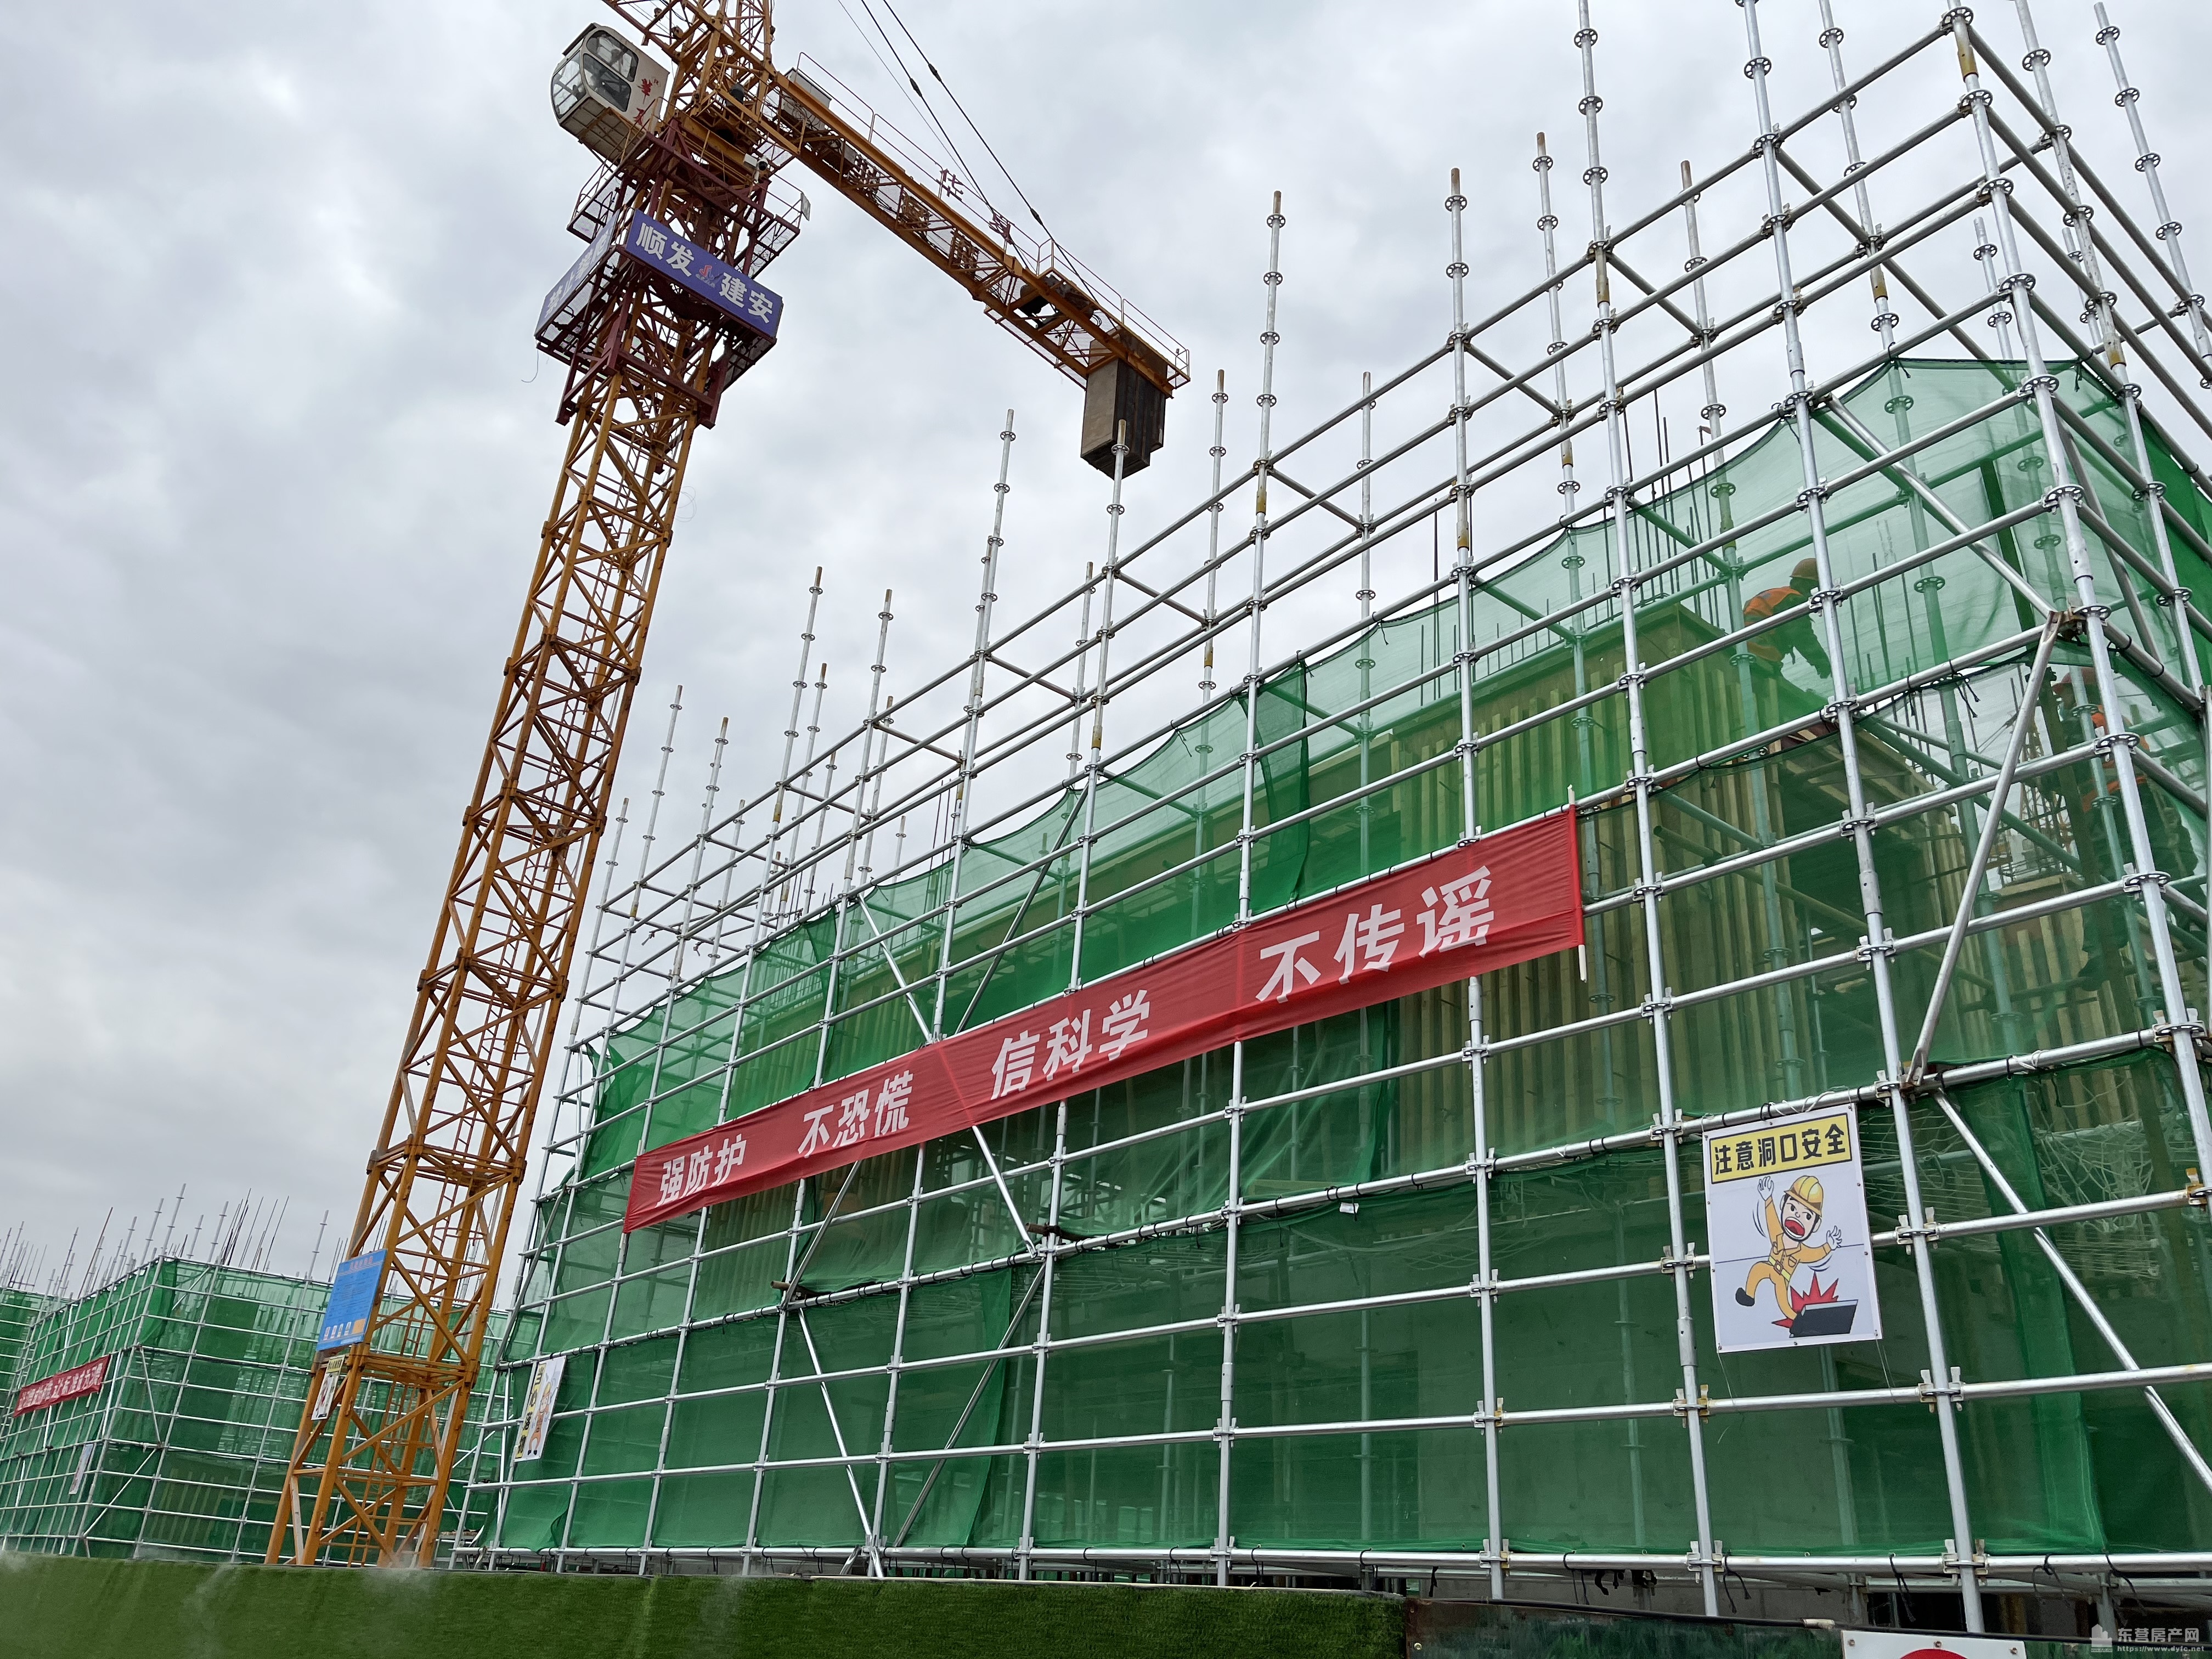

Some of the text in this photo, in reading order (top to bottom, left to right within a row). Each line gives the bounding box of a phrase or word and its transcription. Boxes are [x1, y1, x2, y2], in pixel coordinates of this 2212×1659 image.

[544, 229, 610, 318] 禁止攀爬
[636, 222, 773, 324] 顺发 建安
[656, 865, 1494, 1208] 强防护 不恐慌 信科学 不传谣
[1715, 1123, 1846, 1175] 注意洞口安全
